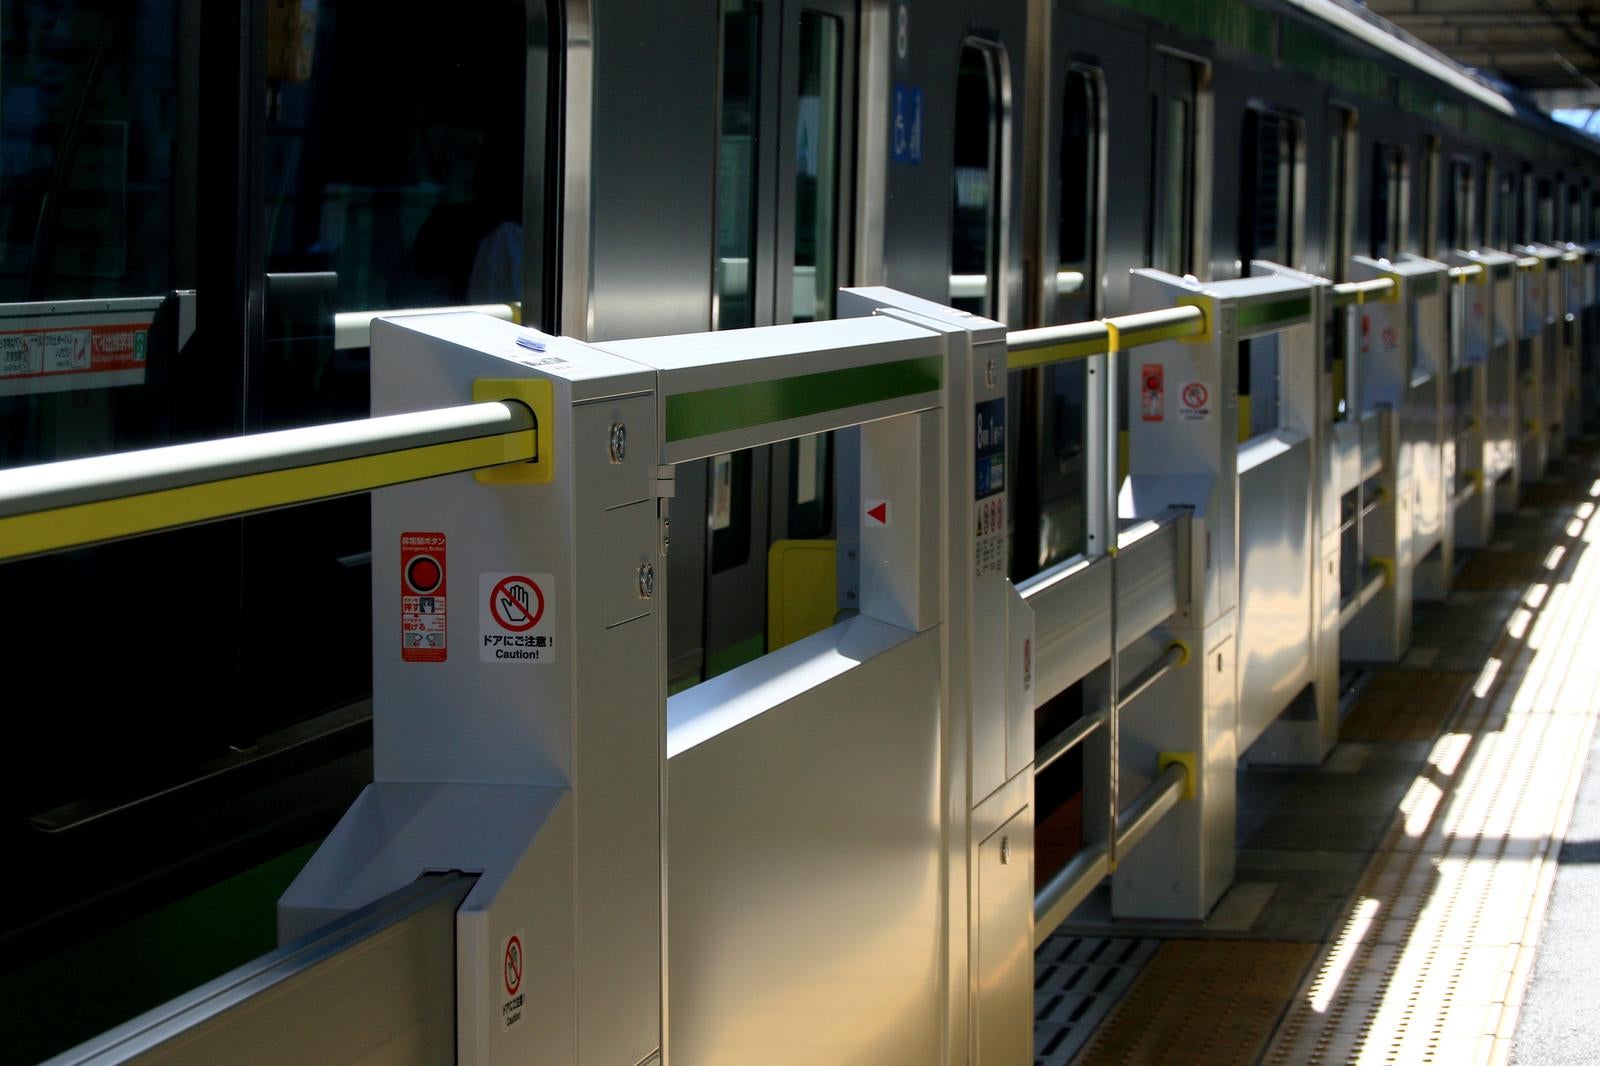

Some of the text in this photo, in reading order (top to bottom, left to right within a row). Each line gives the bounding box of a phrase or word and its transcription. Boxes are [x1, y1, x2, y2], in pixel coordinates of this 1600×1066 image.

[897, 4, 909, 59] 8
[403, 603, 419, 612] 押す
[495, 648, 540, 660] Caution!
